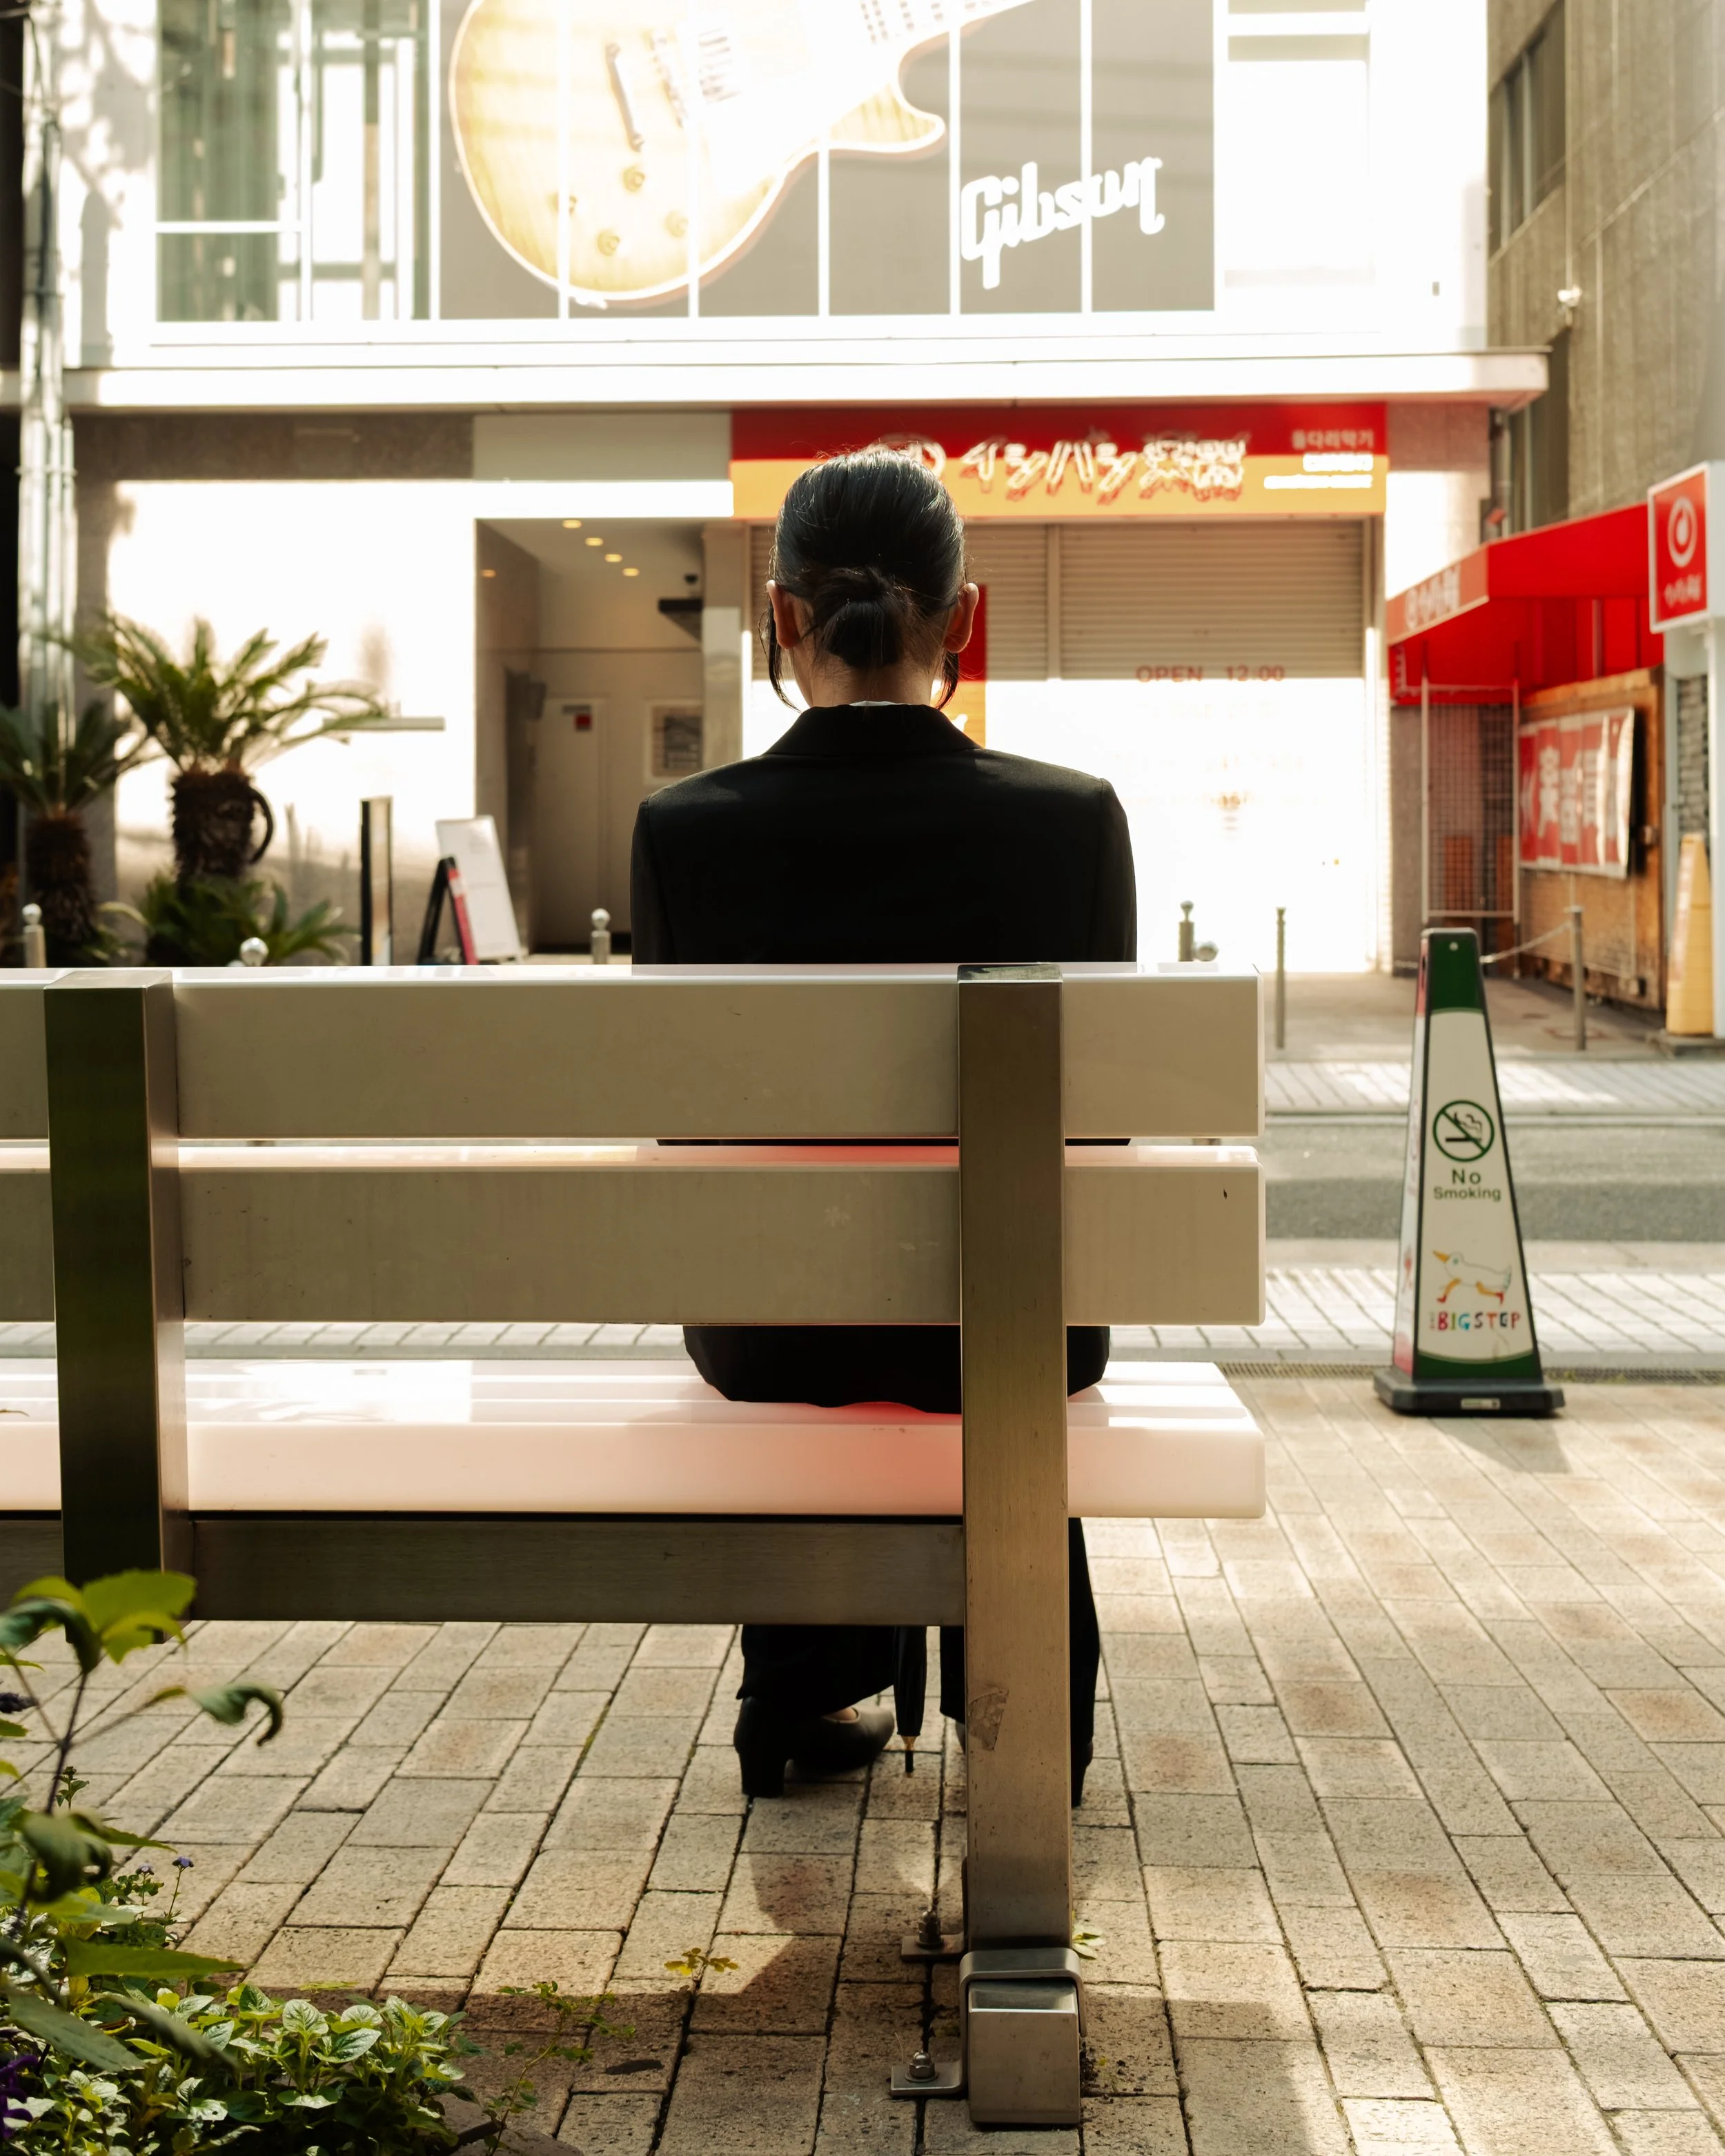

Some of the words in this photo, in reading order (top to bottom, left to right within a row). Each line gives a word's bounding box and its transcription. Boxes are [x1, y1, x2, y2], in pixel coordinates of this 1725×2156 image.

[960, 157, 1165, 289] Gibson
[1136, 665, 1203, 682] OPEN
[1452, 1169, 1481, 1185] No
[1434, 1187, 1501, 1202] Smoking
